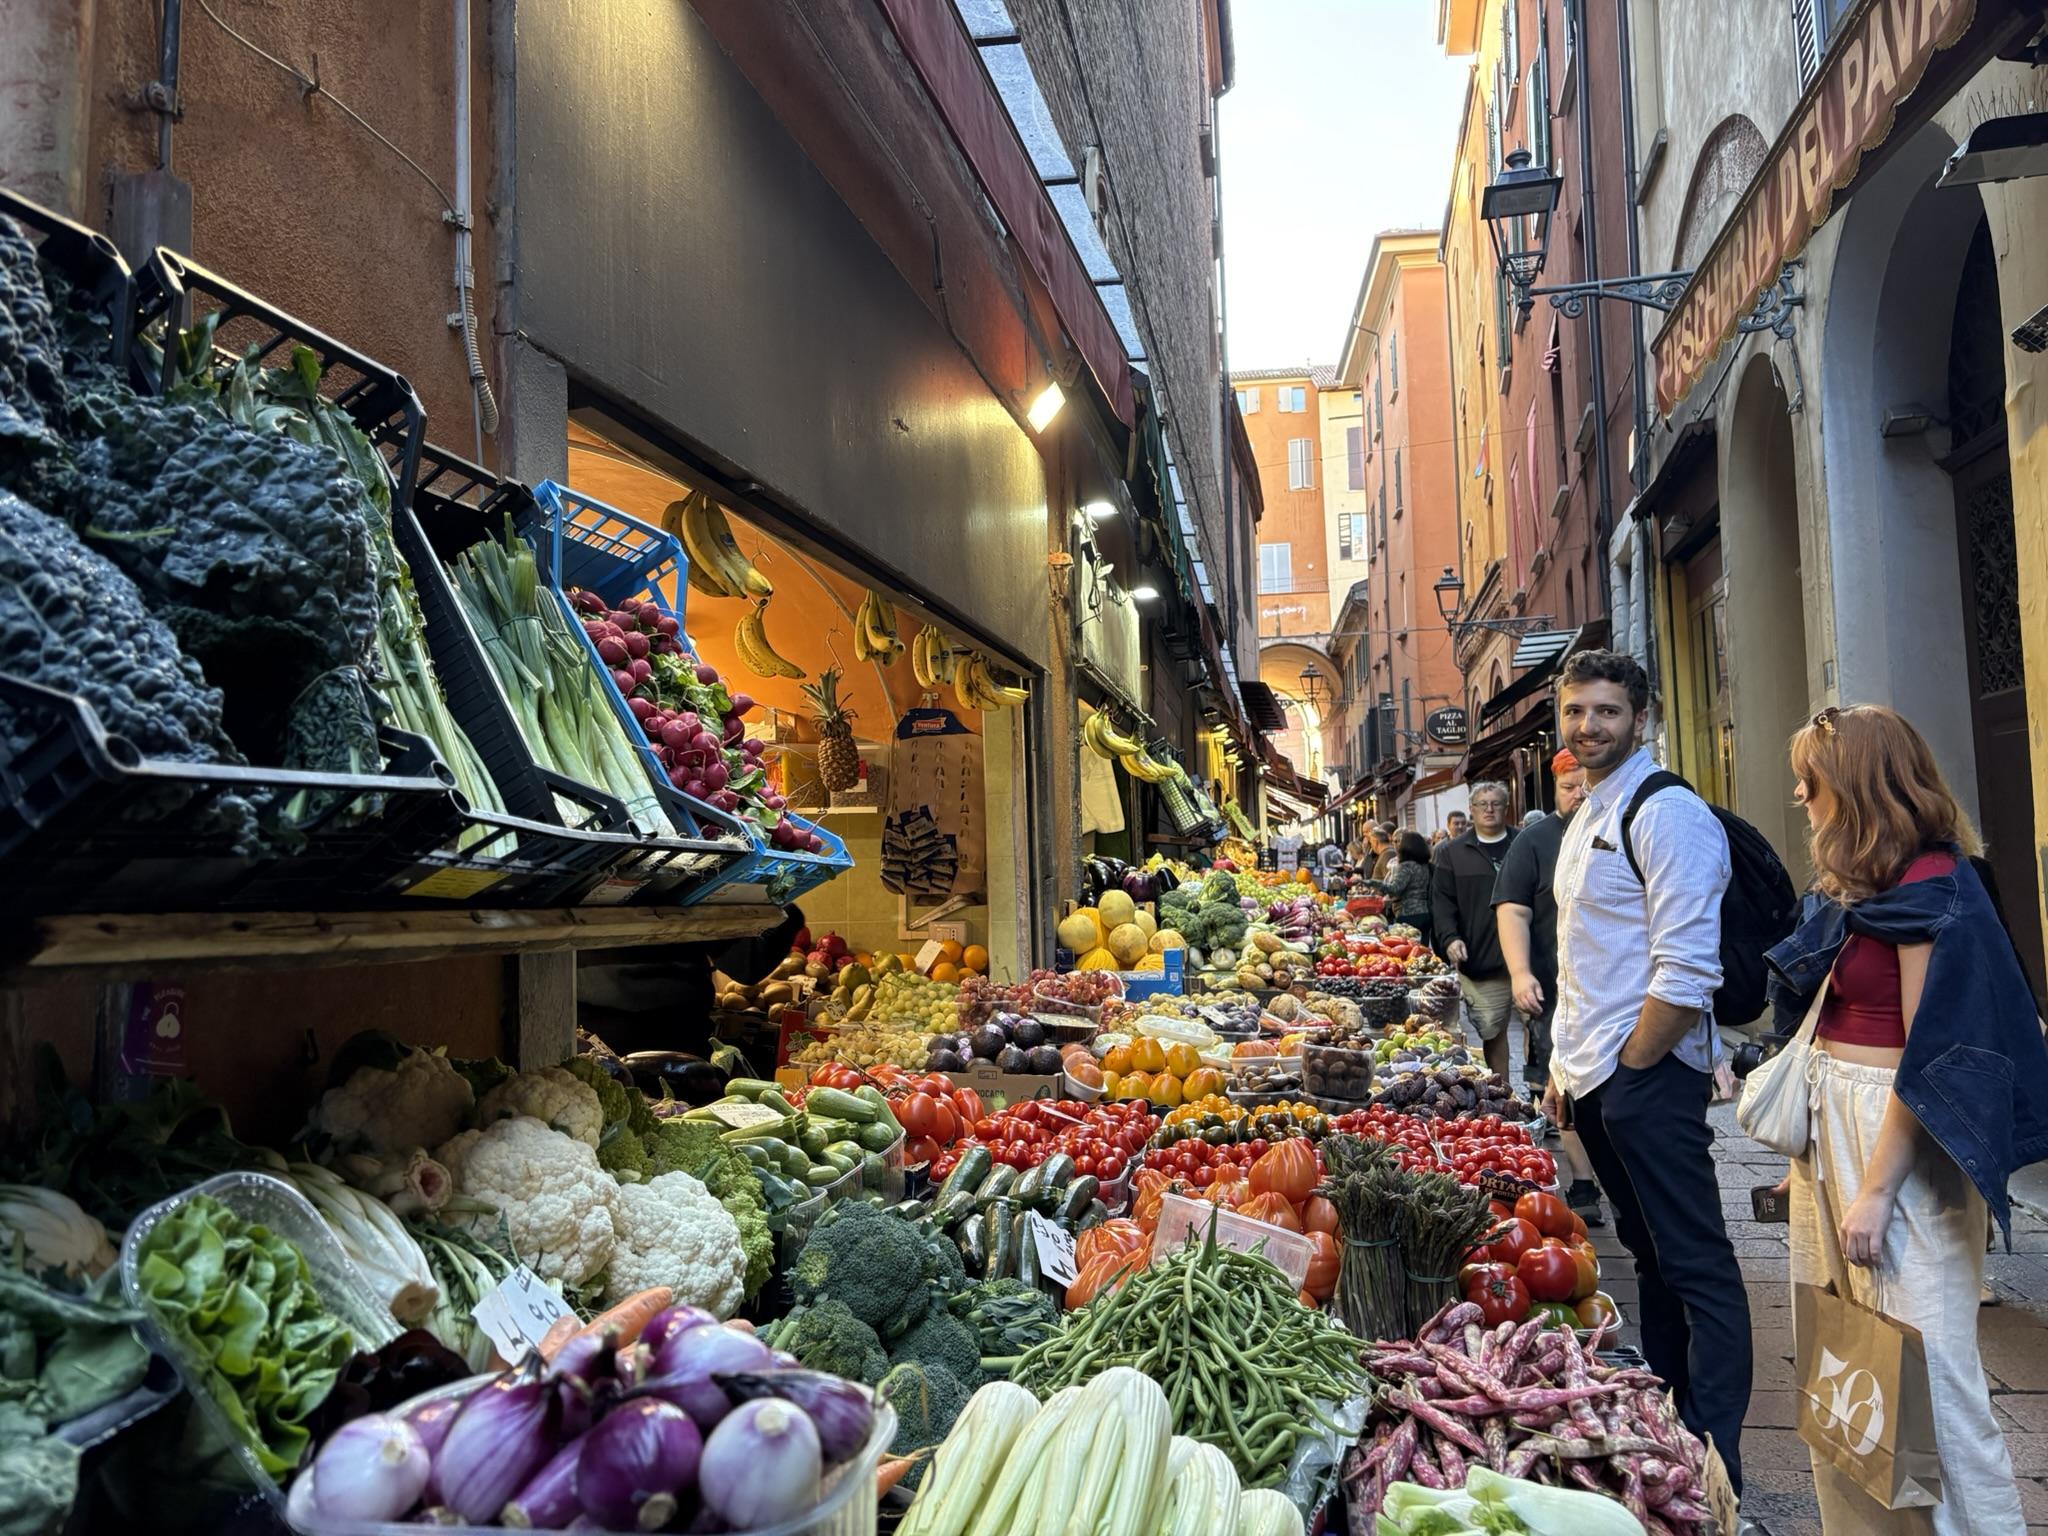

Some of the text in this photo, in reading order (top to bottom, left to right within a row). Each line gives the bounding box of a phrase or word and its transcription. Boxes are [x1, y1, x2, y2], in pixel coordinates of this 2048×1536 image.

[1660, 187, 1774, 402] PESCHERIA
[1779, 92, 1833, 243] DEL
[1439, 712, 1463, 720] PIZZA
[1436, 726, 1467, 734] TAGLIO
[974, 1088, 1005, 1098] VOCADO
